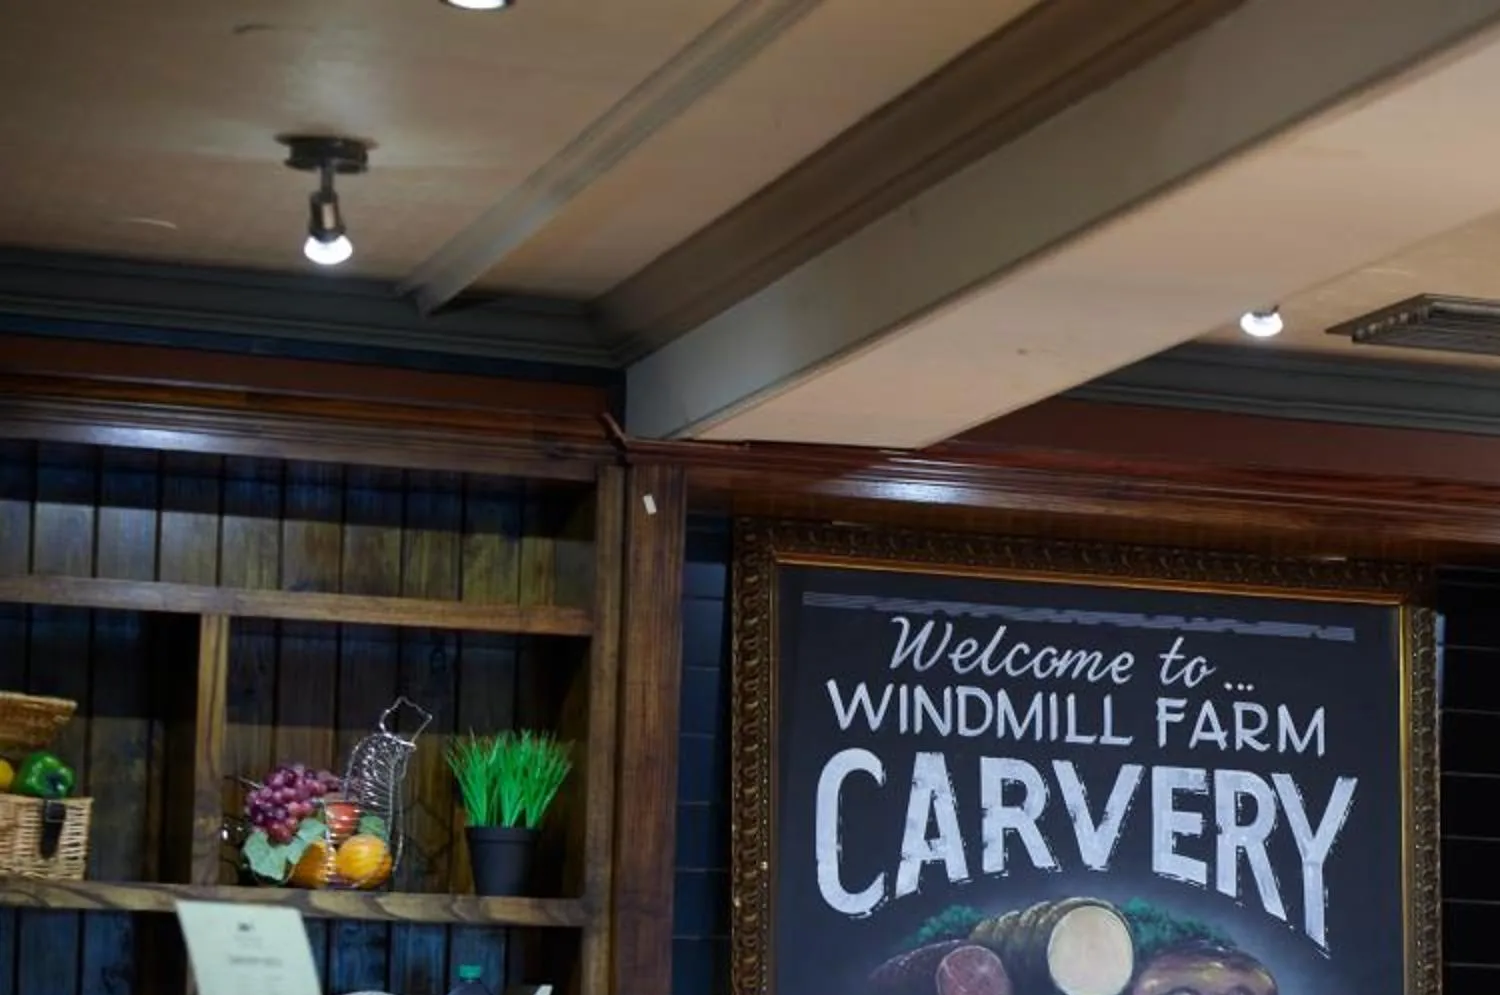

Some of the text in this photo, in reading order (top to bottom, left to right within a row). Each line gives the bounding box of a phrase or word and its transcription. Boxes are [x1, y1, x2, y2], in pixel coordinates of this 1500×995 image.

[889, 615, 1135, 686] Welcome
[826, 679, 1326, 758] WINDMILL FARM
[814, 747, 1359, 960] CARVERY
